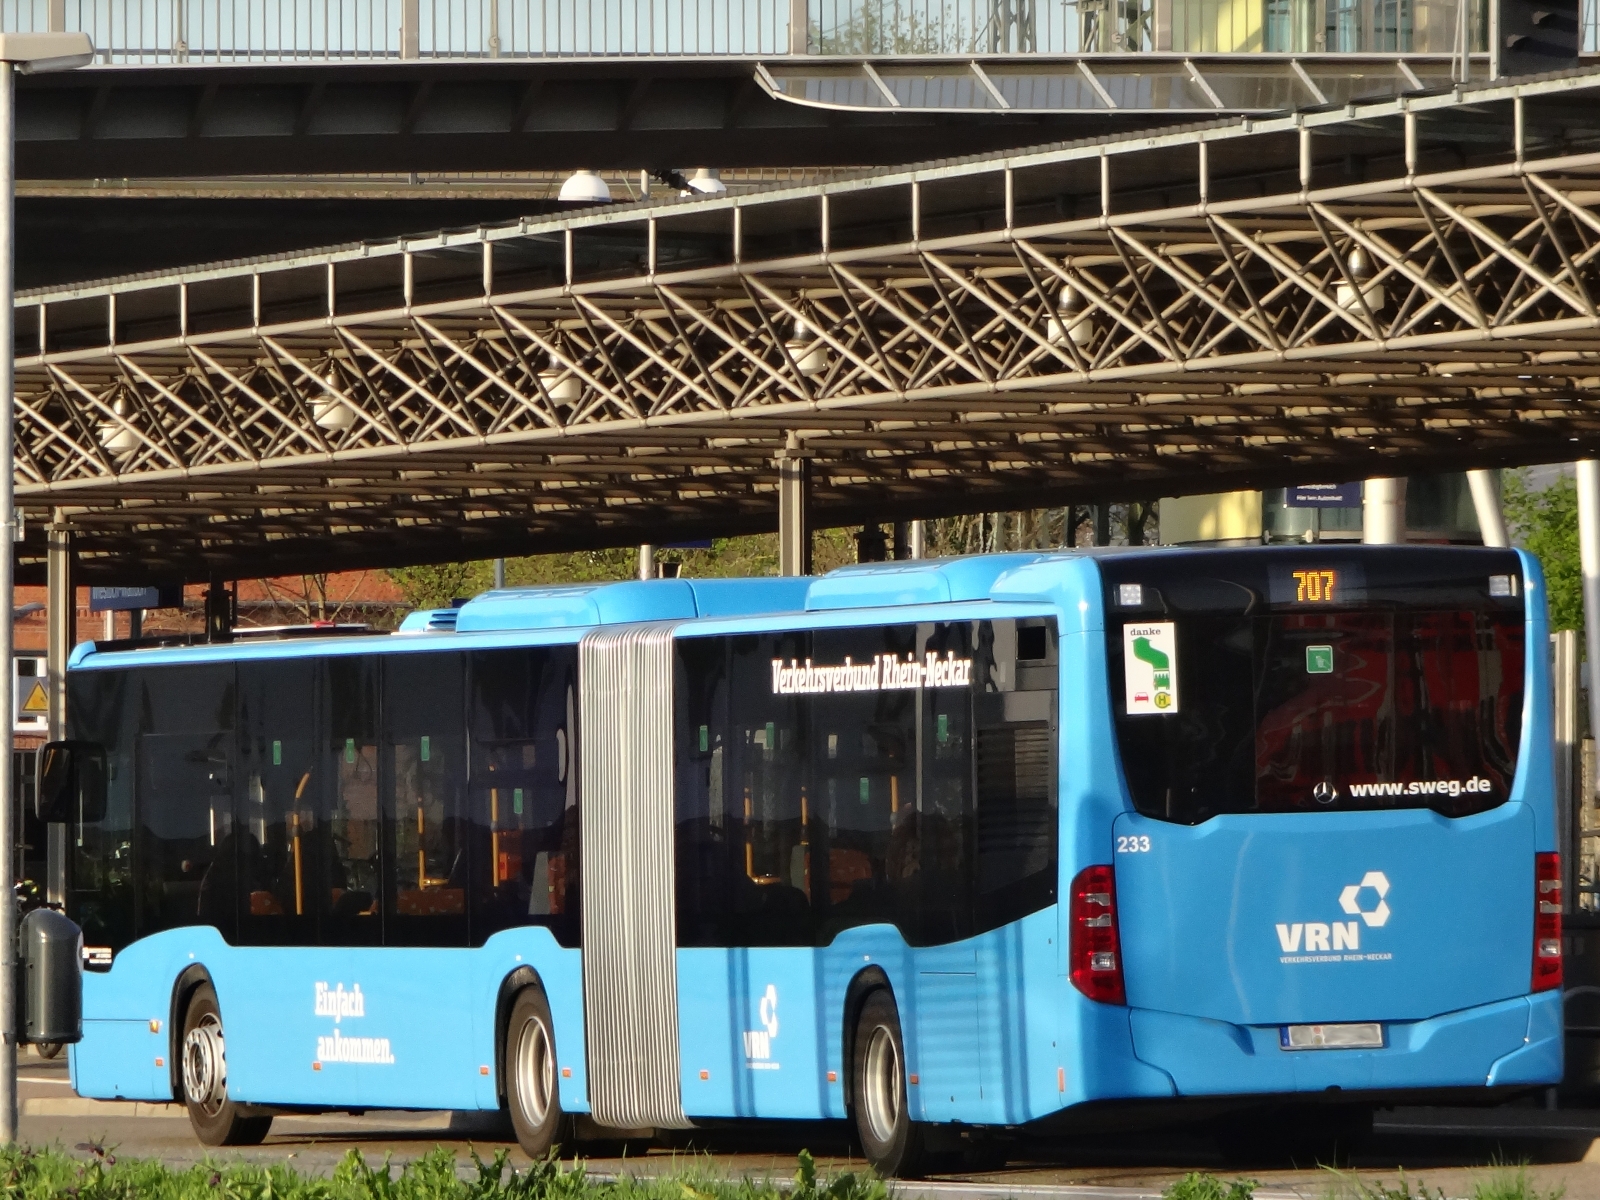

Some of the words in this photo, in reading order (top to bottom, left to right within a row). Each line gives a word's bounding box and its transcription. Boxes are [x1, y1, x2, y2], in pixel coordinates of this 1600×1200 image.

[1292, 571, 1334, 601] 707
[1130, 628, 1161, 636] danke
[771, 655, 880, 694] Verkehrsverbund
[881, 650, 971, 690] Rhein-Neckar
[1349, 776, 1491, 797] www.sweg.de
[1117, 836, 1151, 853] 233
[1275, 921, 1359, 953] VRN
[1343, 953, 1393, 961] RHEIN-NECKAR
[314, 981, 365, 1024] Einfach
[317, 1028, 395, 1065] ankommen.
[743, 1031, 770, 1059] VRN
